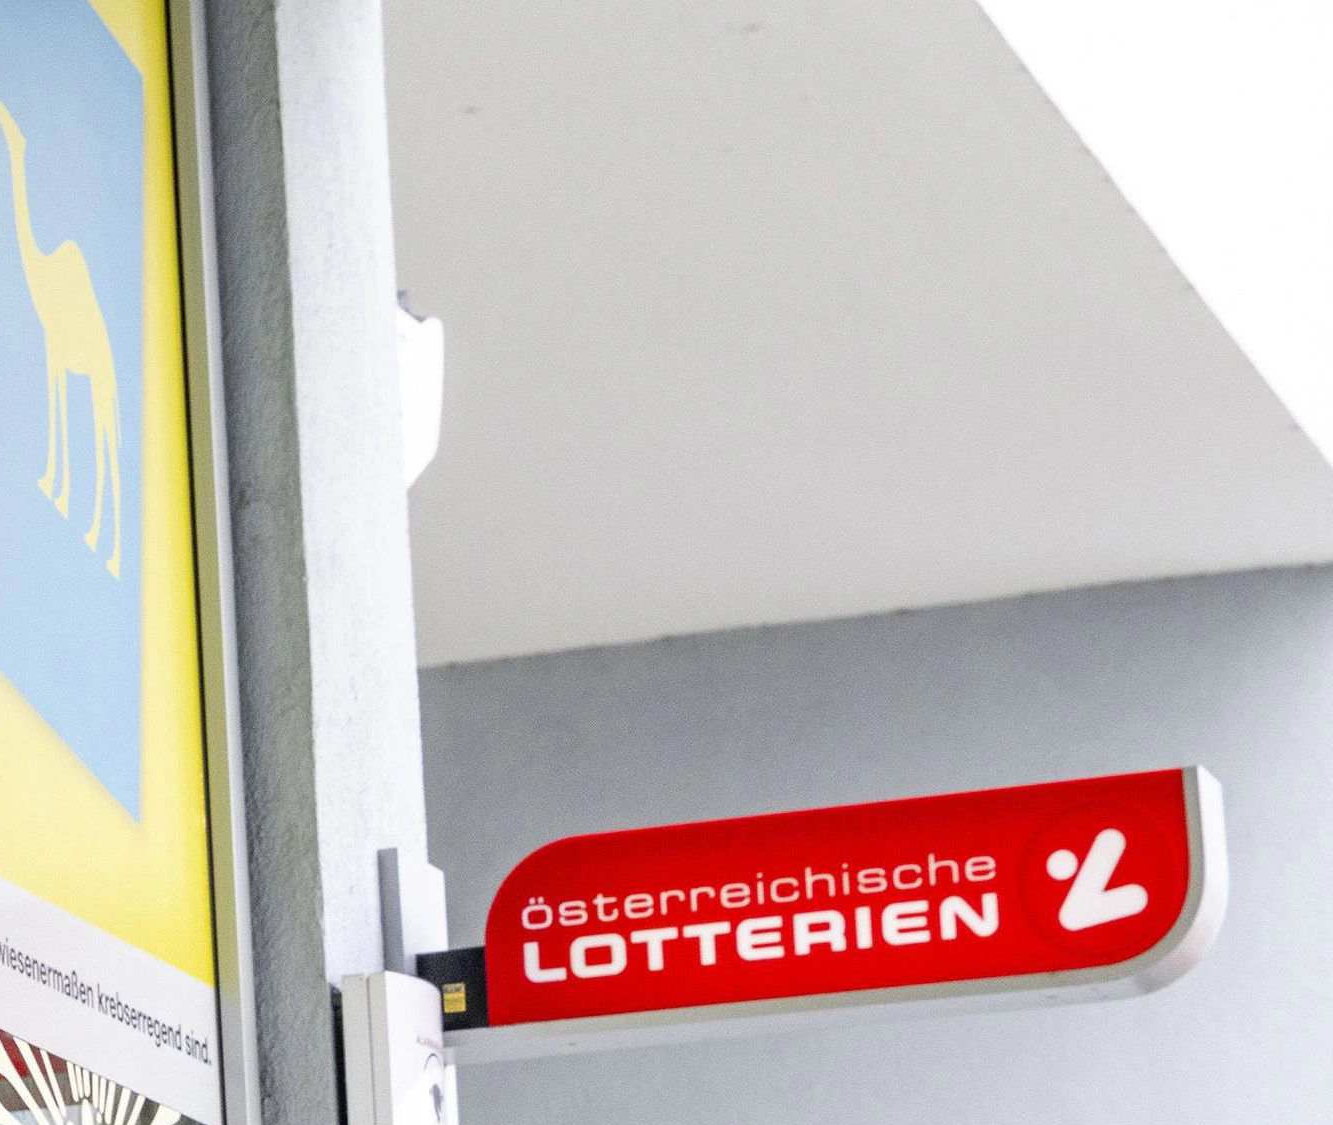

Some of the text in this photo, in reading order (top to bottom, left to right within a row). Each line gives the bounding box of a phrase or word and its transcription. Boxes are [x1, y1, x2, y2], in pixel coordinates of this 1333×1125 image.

[521, 853, 998, 930] österreichische
[522, 892, 1001, 984] LOTTERIEN
[97, 983, 183, 1052] krebserregend
[185, 1029, 212, 1066] sind.
